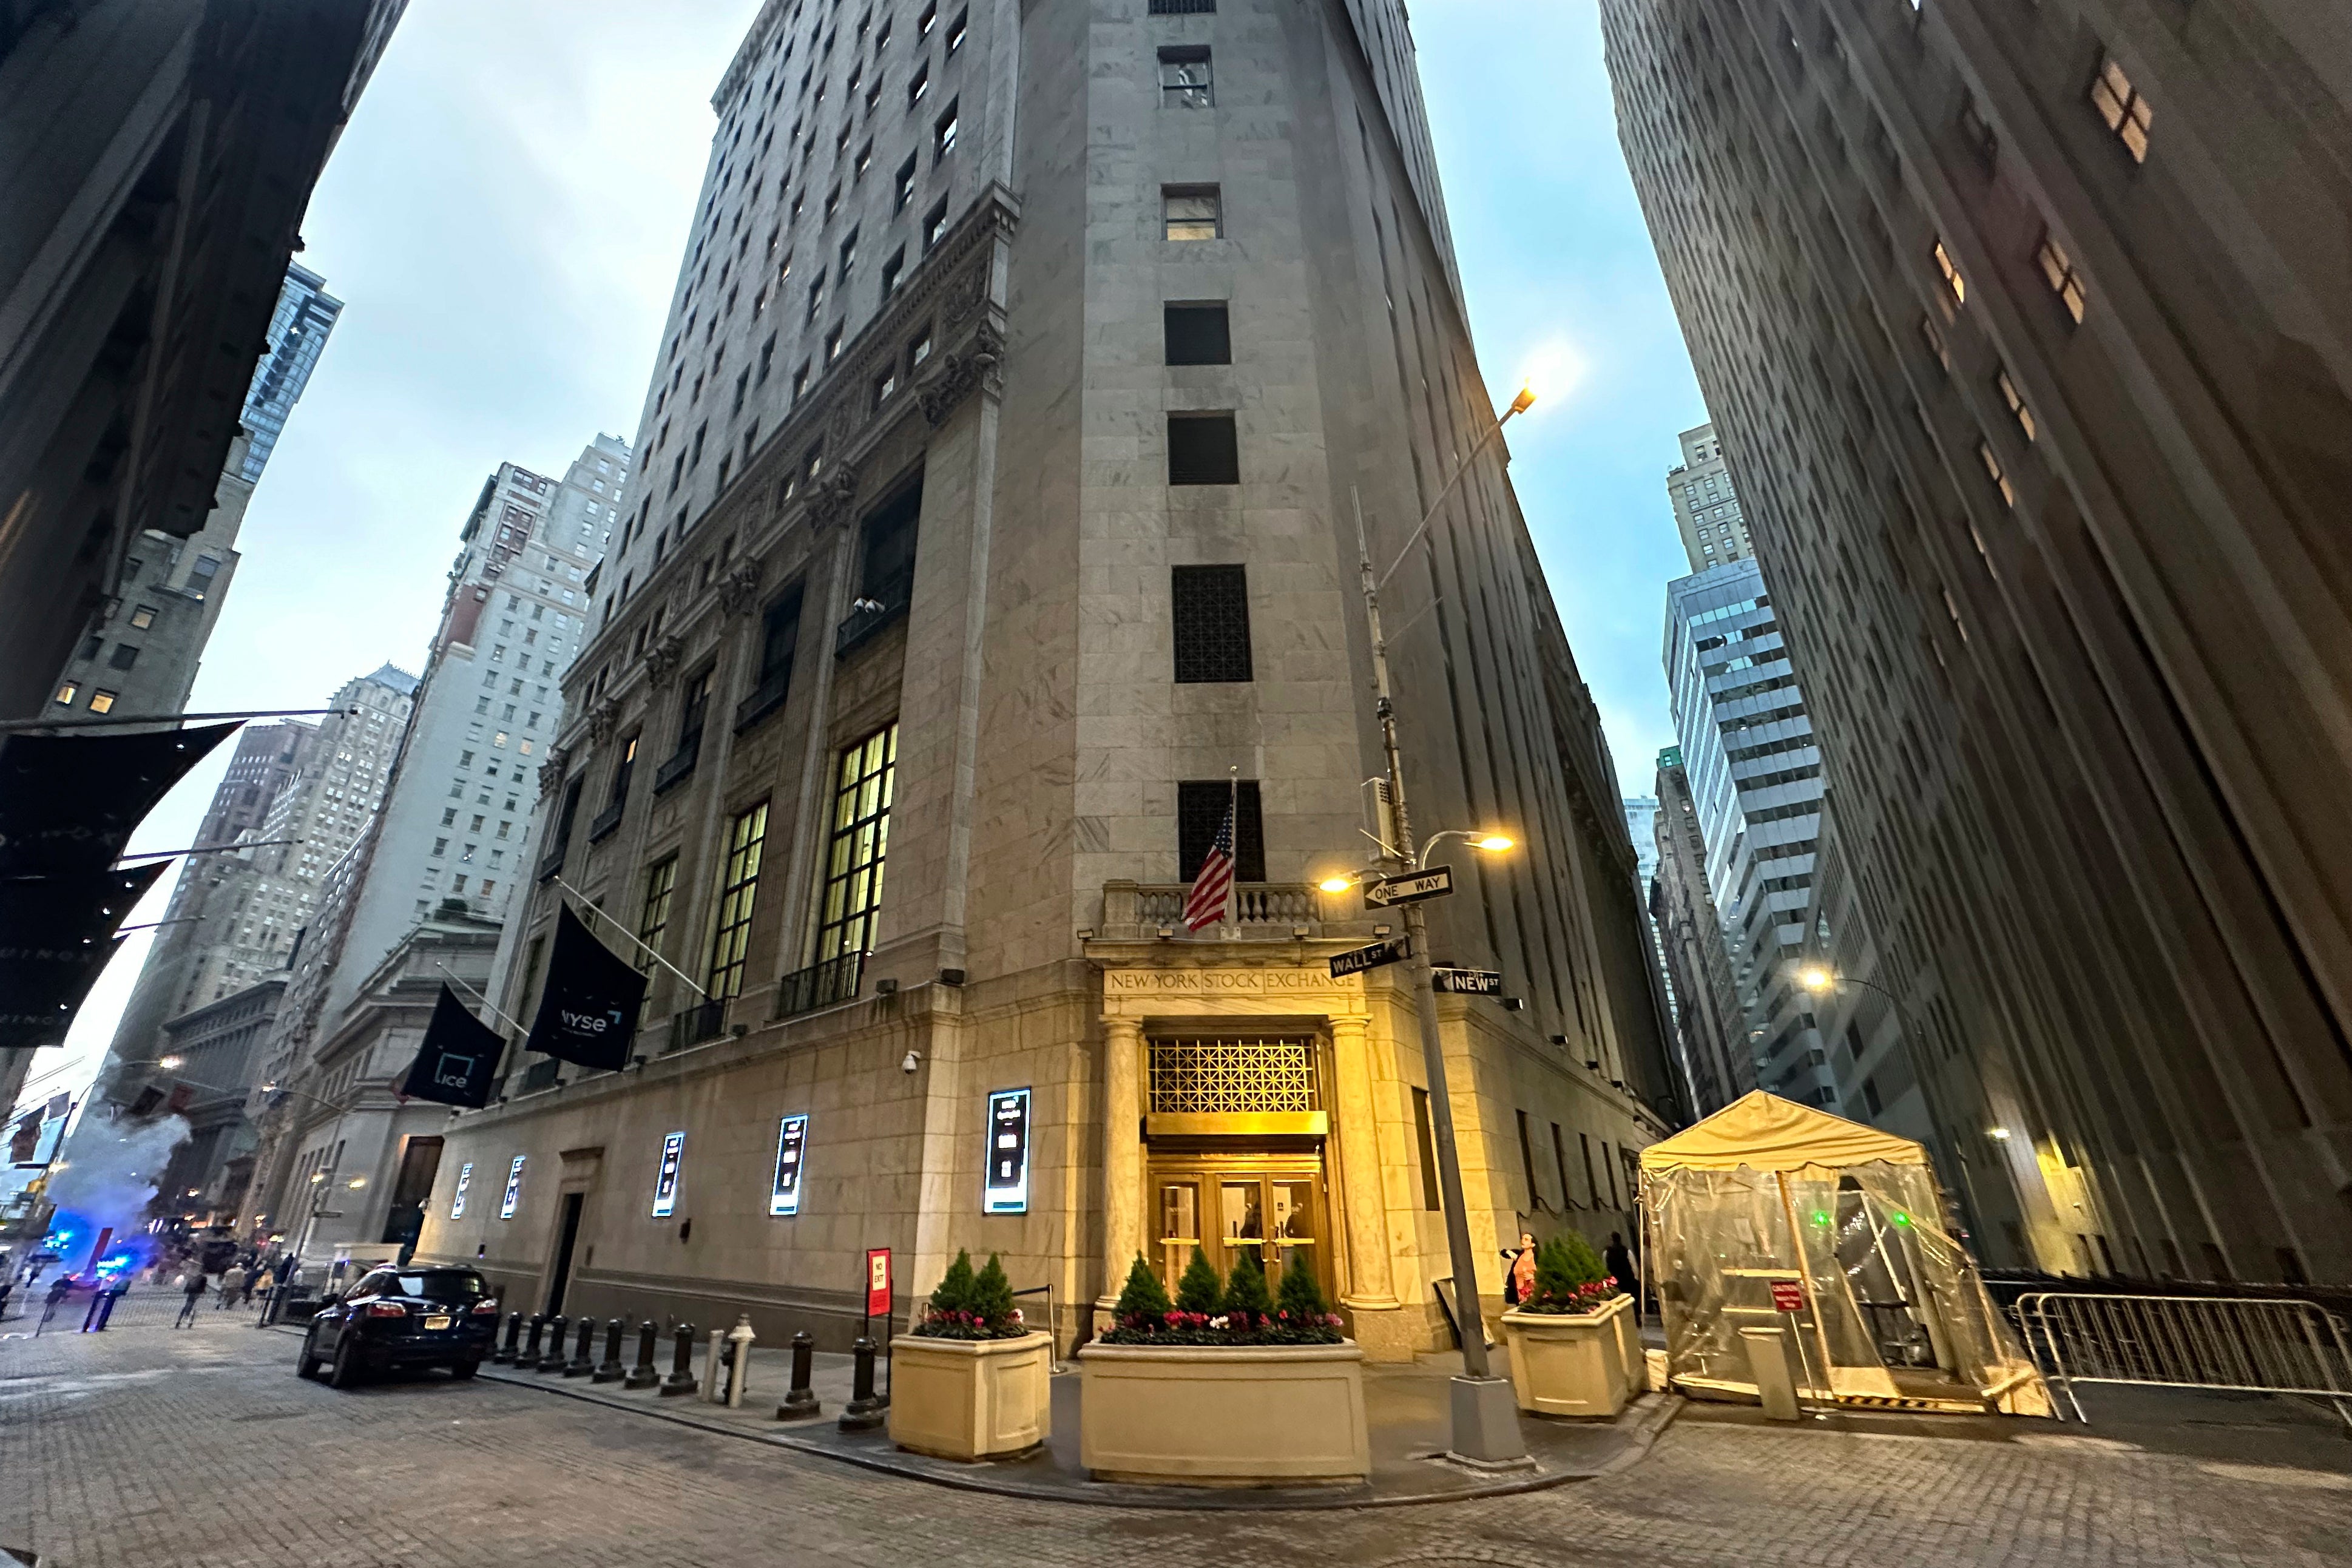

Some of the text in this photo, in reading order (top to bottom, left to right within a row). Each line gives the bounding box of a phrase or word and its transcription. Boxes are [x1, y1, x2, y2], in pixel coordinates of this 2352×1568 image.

[1374, 877, 1440, 899] ONE WAY
[1333, 953, 1372, 973] WALL
[1371, 949, 1382, 959] ST
[1111, 973, 1354, 989] NEW YORK STOCK EXCHANGE
[1455, 976, 1489, 992] NEW
[874, 1274, 884, 1283] EXIT
